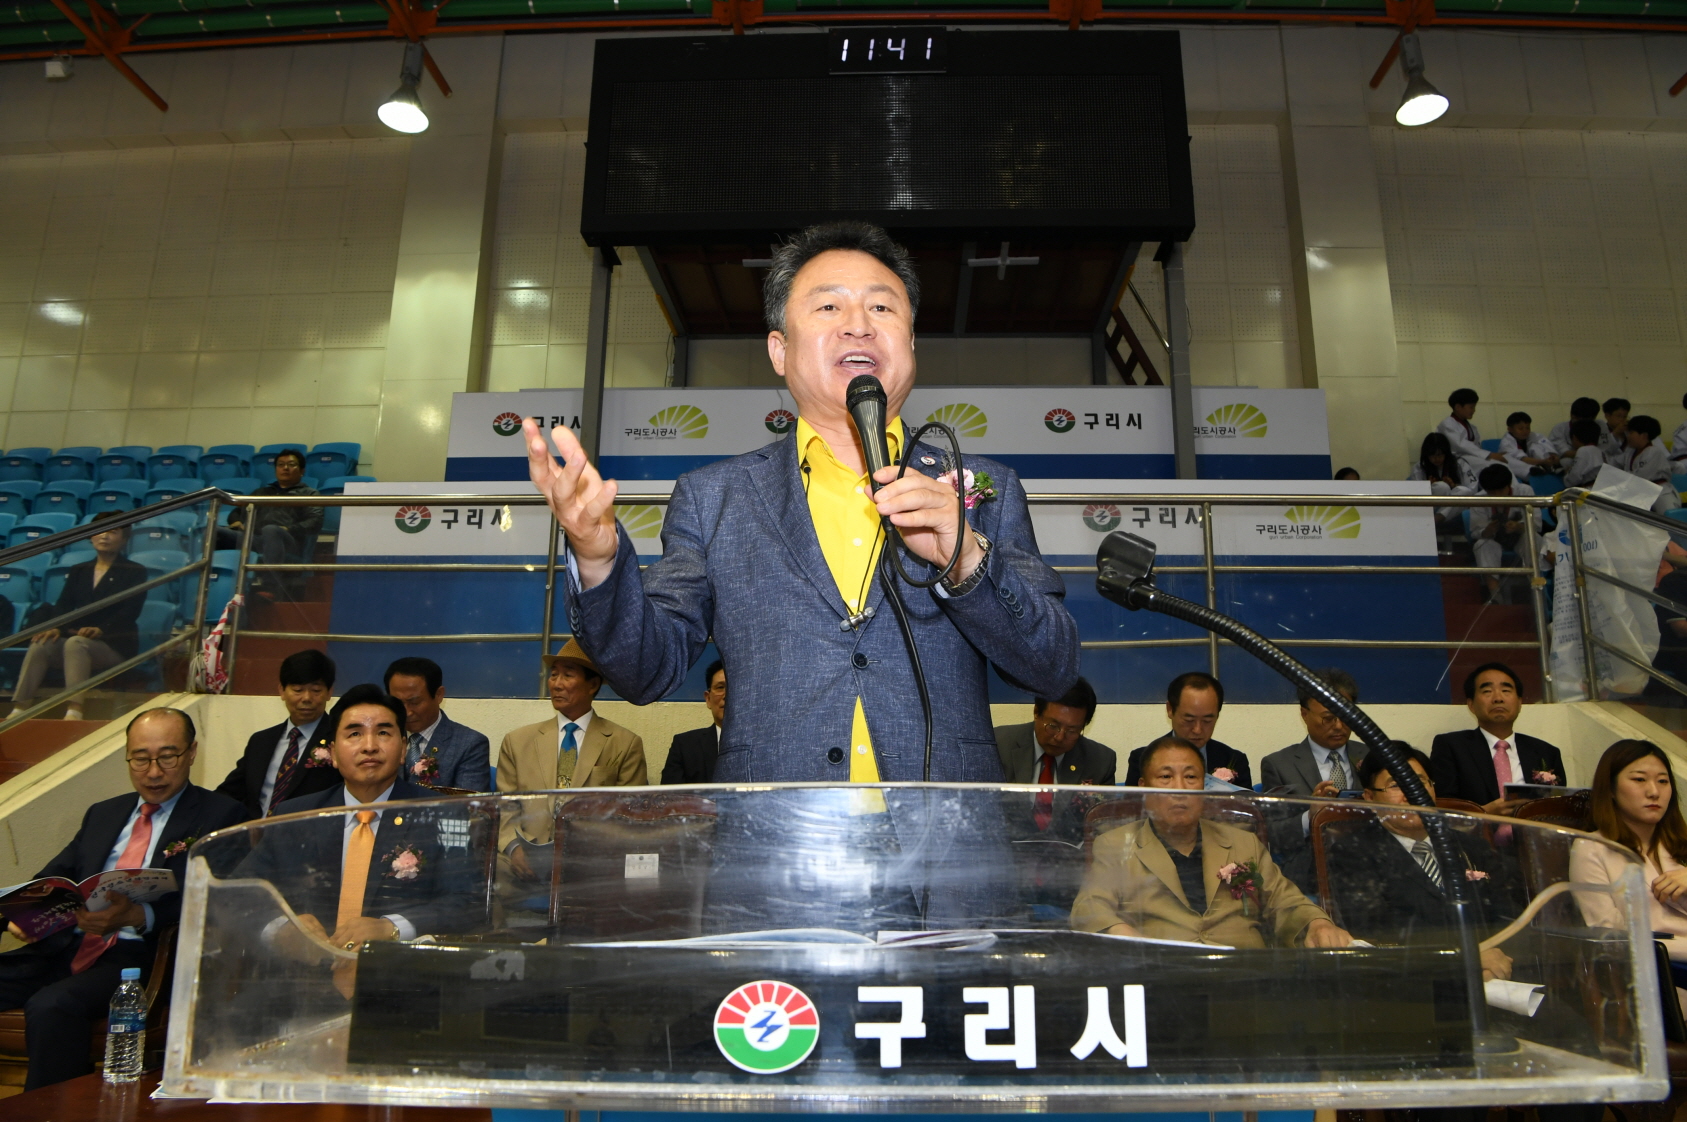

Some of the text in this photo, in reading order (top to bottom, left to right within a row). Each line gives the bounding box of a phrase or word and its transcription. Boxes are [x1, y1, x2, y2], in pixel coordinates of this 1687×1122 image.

[1083, 413, 1142, 430] 구리시
[624, 428, 677, 436] 구리도시공사
[1193, 426, 1236, 435] 리도시공사
[1131, 507, 1204, 529] 구리시
[1256, 524, 1322, 536] 구리도시공사
[855, 984, 1148, 1069] 구리시
